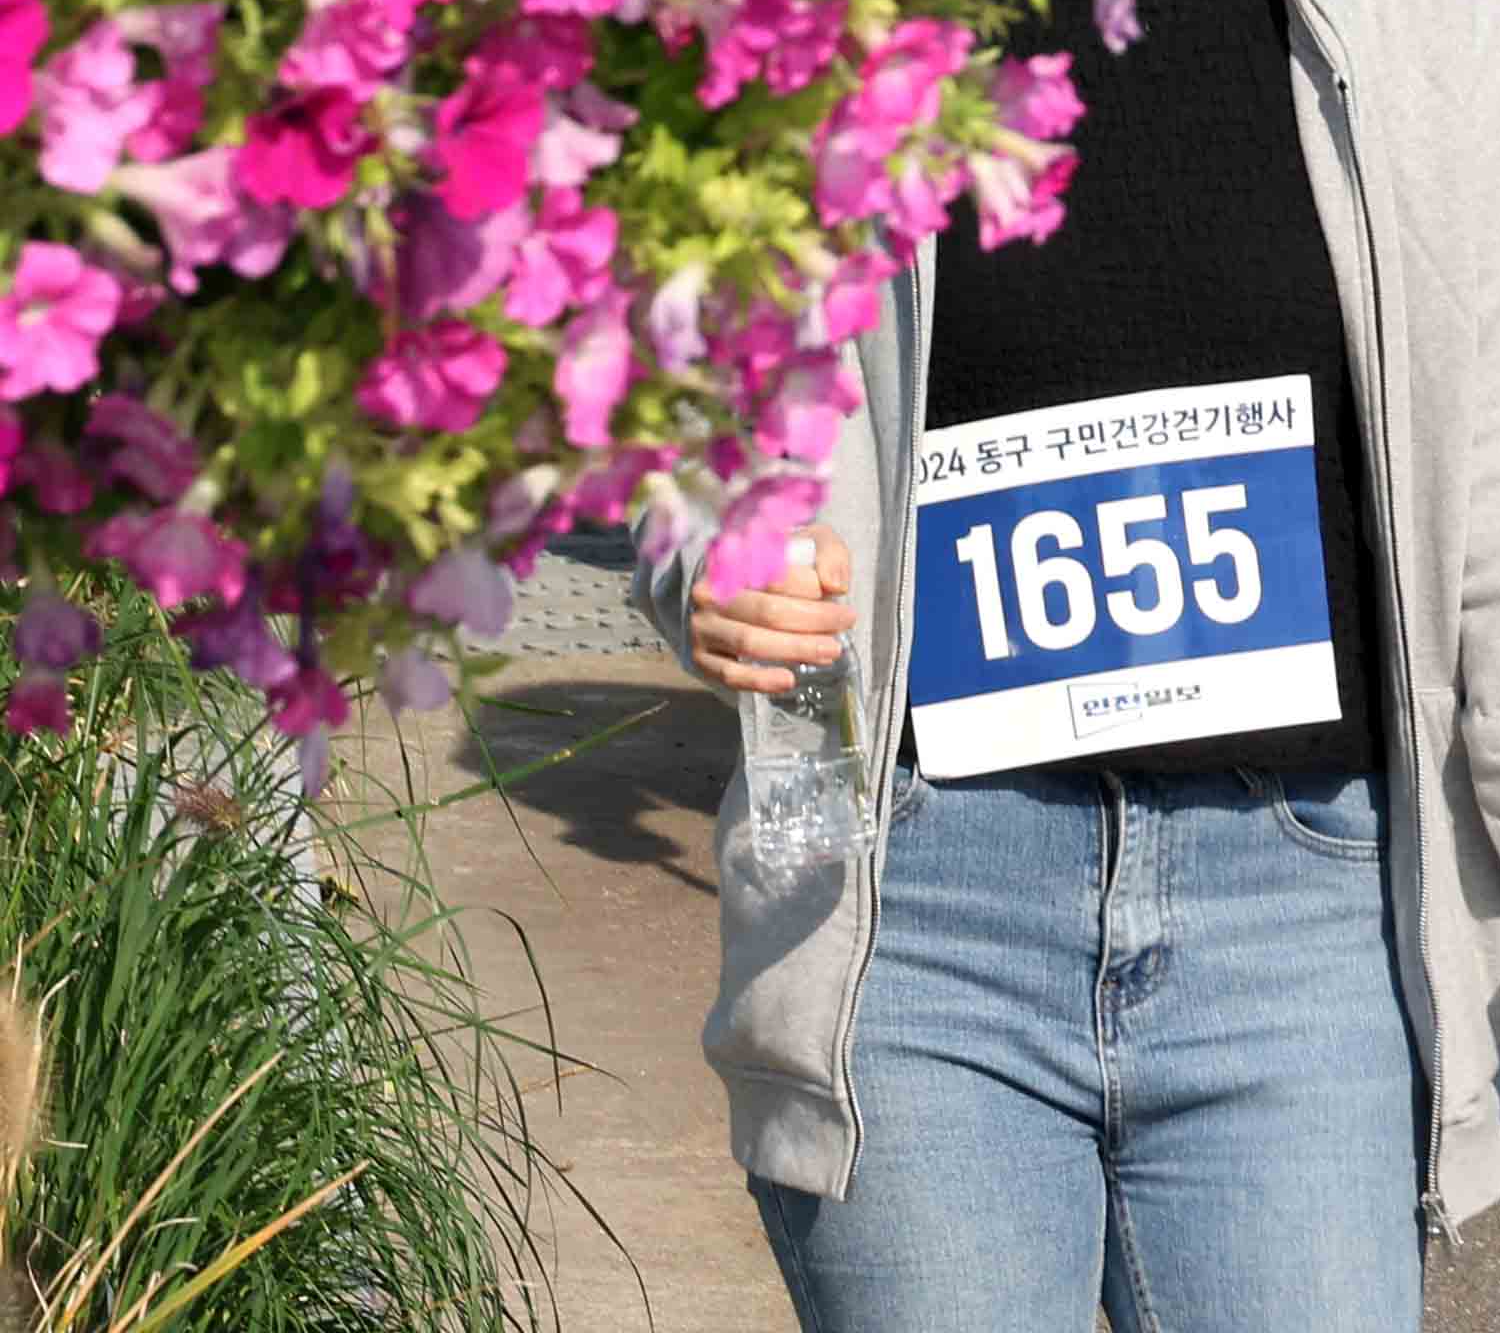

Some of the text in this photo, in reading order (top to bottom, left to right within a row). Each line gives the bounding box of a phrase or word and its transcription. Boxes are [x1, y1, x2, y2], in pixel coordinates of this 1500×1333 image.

[918, 397, 1297, 485] 24 동구 구민건강걷기행사
[956, 483, 1263, 661] 1655
